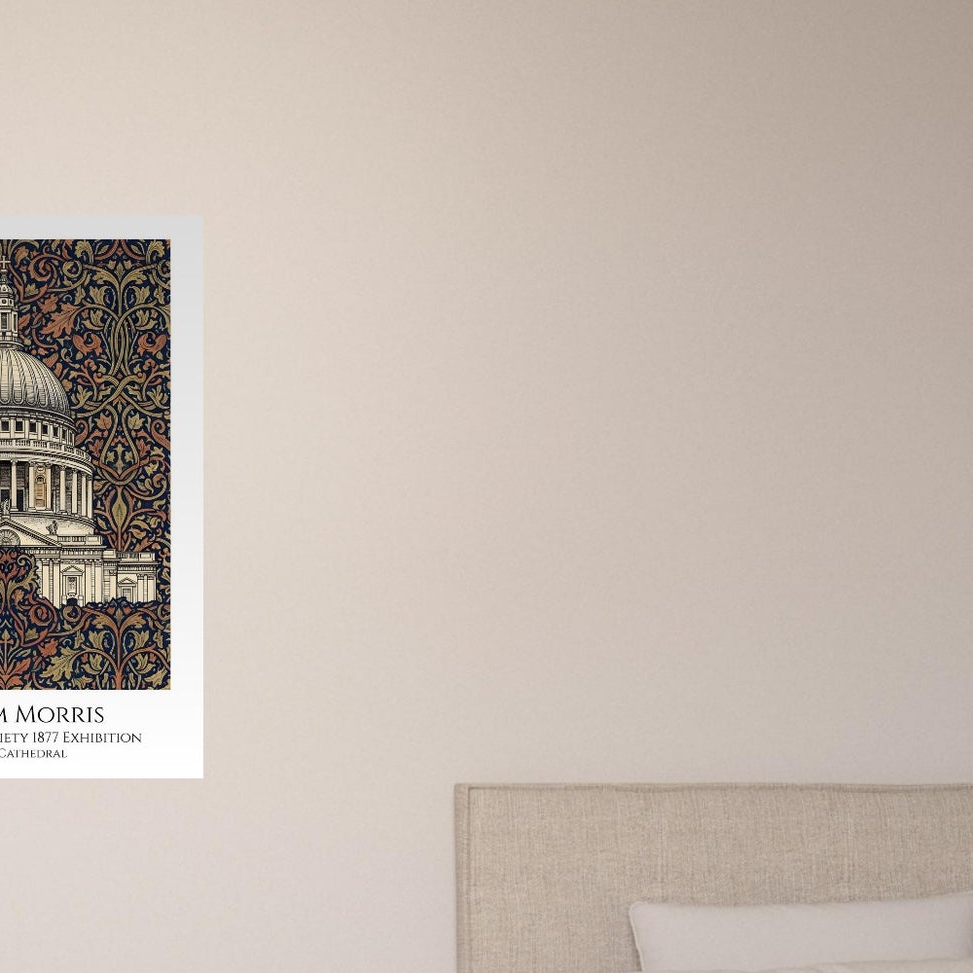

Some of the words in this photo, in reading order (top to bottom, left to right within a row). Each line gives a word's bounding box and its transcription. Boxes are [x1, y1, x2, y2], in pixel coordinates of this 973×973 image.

[15, 704, 105, 724] MORRIS
[33, 731, 59, 744] 1877
[63, 731, 142, 744] EXHIBITION
